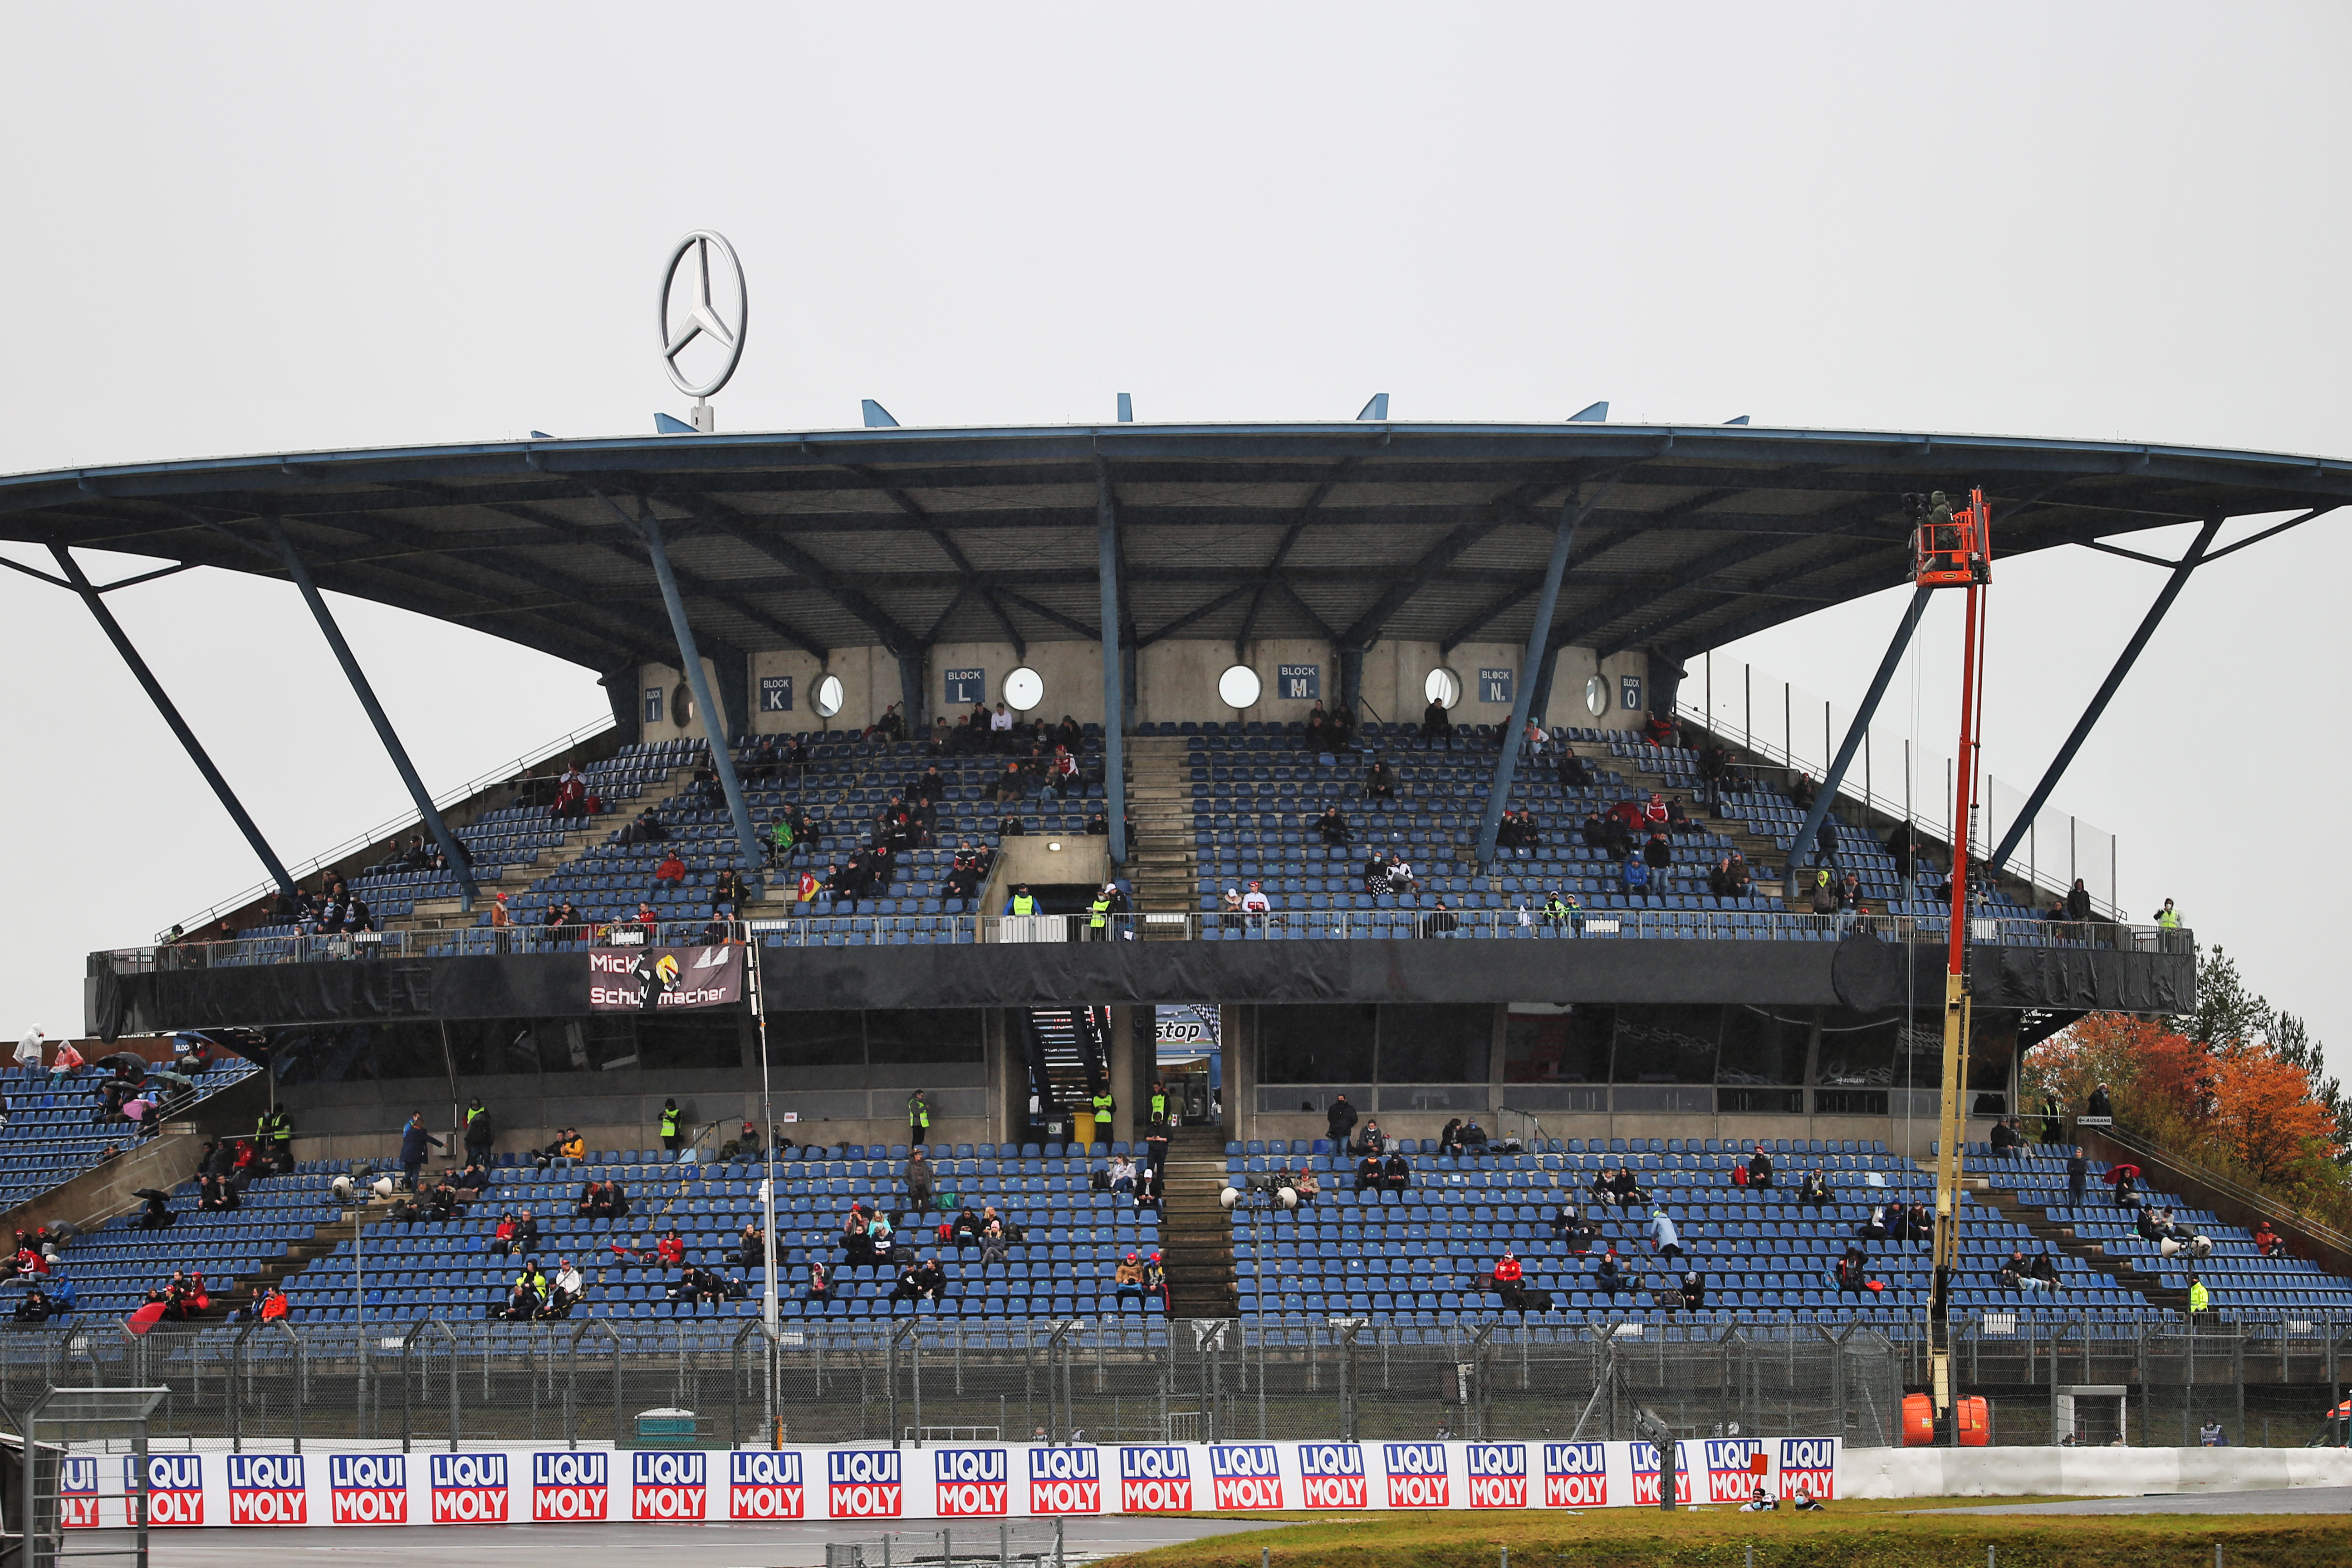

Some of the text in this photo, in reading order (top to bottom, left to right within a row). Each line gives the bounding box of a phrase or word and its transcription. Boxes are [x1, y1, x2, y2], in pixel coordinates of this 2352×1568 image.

[763, 679, 789, 688] BLOCK
[948, 671, 980, 680] BLOCK
[1291, 679, 1307, 697] M
[1482, 671, 1509, 679] BLOCK
[1623, 678, 1639, 687] BLOCK
[647, 690, 661, 699] BLOCK
[771, 691, 783, 709] K
[959, 683, 971, 701] L
[652, 701, 655, 720] I
[590, 954, 635, 974] Mick
[831, 1453, 897, 1483] LIQUI
[938, 1452, 1004, 1481] LIQUI
[1032, 1450, 1096, 1480] LIQUI
[1122, 1449, 1187, 1479] LIQUI
[1212, 1447, 1276, 1476] LIQUI
[1301, 1446, 1362, 1475] LIQUI
[1387, 1446, 1444, 1474] LIQUI
[1469, 1447, 1524, 1475] LIQUI
[1546, 1446, 1603, 1474] LIQUI
[1632, 1444, 1686, 1471] LIQI
[1783, 1441, 1832, 1469] LIQUI
[127, 1457, 199, 1489] LQUI
[231, 1457, 301, 1488] LIQUI
[333, 1457, 402, 1488] LIQUI
[434, 1456, 504, 1487] LIQUI
[536, 1455, 604, 1485] LIQUI
[637, 1454, 702, 1485] LIQUI
[734, 1454, 799, 1485] LIQUI
[939, 1484, 1006, 1513] MOLY
[1034, 1482, 1098, 1510] MOLY
[1125, 1481, 1190, 1509] MOLY
[1217, 1479, 1279, 1507] MOLY
[1305, 1478, 1365, 1505] MOLY
[1390, 1477, 1447, 1504] MOLY
[1471, 1478, 1526, 1505] MOLY
[1548, 1476, 1606, 1504] MOLY
[1635, 1474, 1688, 1502] MOY
[1711, 1472, 1760, 1499] MOLY
[1782, 1471, 1833, 1498] MOLY
[233, 1492, 304, 1521] MOLY
[335, 1491, 406, 1520] MOLY
[436, 1490, 507, 1519] MOLY
[536, 1489, 607, 1517] MOLY
[636, 1488, 705, 1517] MOLY
[733, 1487, 802, 1516] MOLY
[832, 1486, 900, 1514] MOLY
